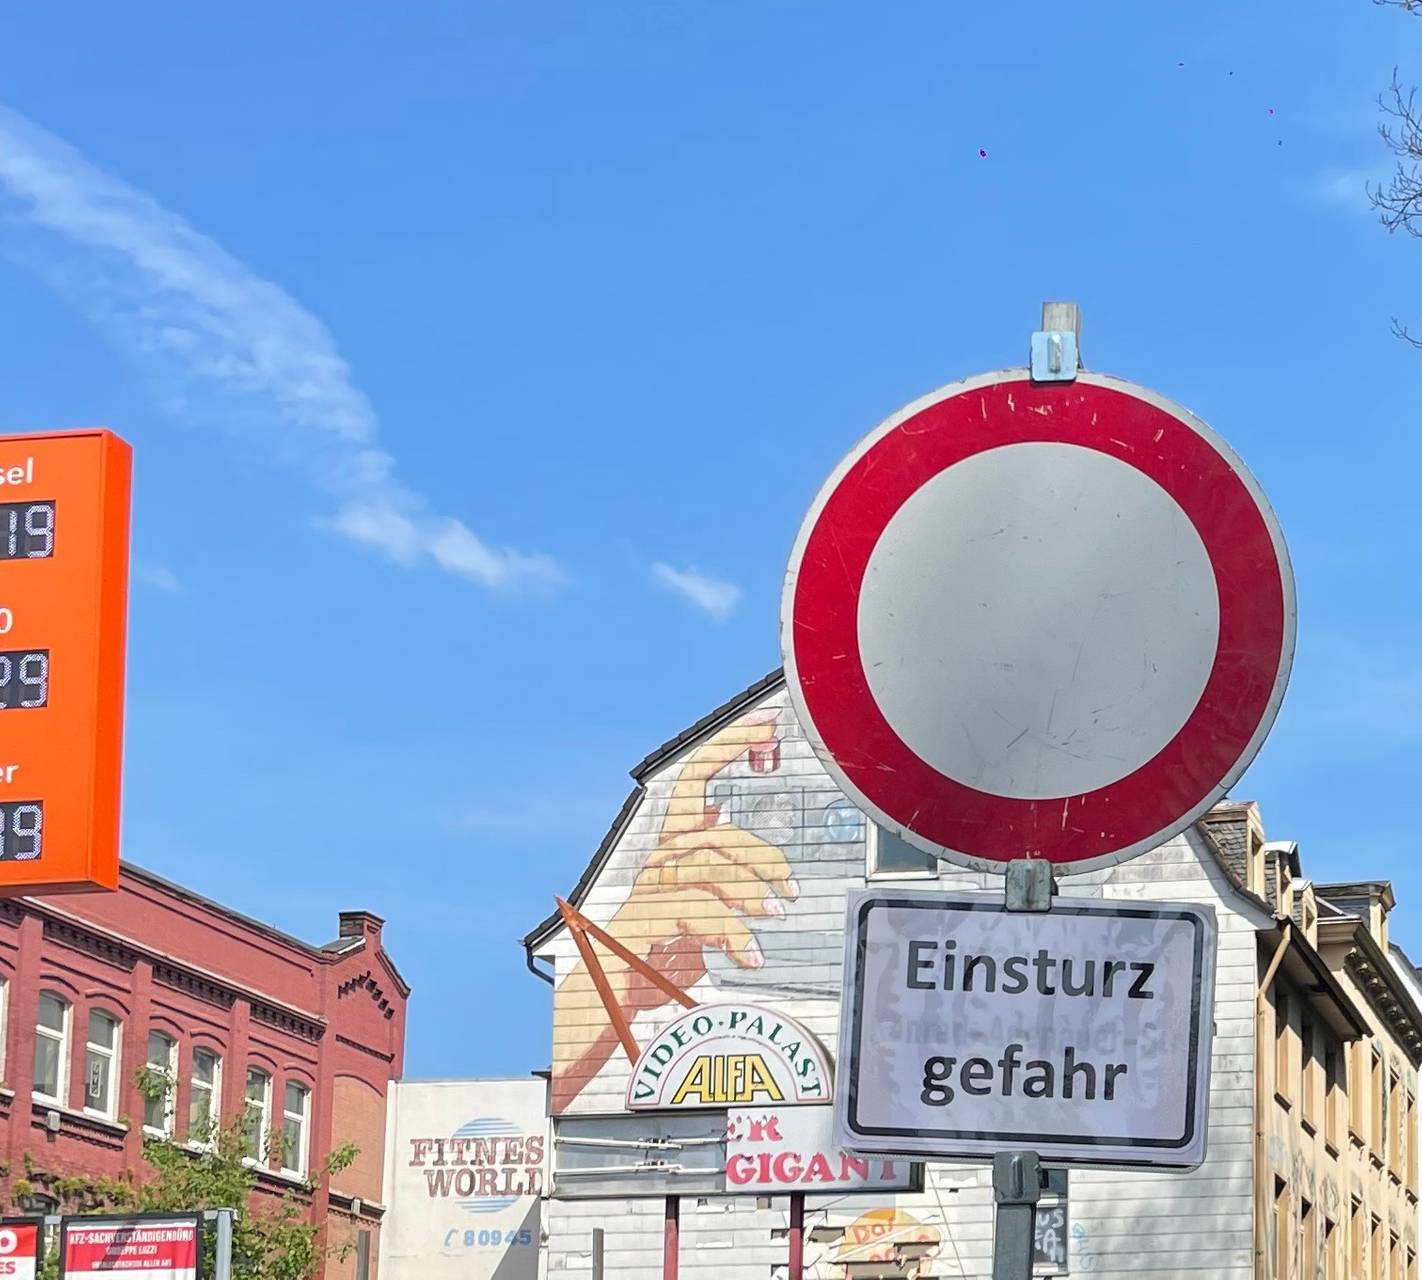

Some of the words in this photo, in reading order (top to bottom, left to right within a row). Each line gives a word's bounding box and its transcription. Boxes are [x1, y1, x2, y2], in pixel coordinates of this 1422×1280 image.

[0, 765, 19, 784] r
[0, 805, 42, 860] 9
[906, 940, 1154, 999] Einsturz
[671, 1054, 785, 1104] ALFA
[920, 1044, 1127, 1107] gefahr
[423, 1167, 544, 1198] WORLD
